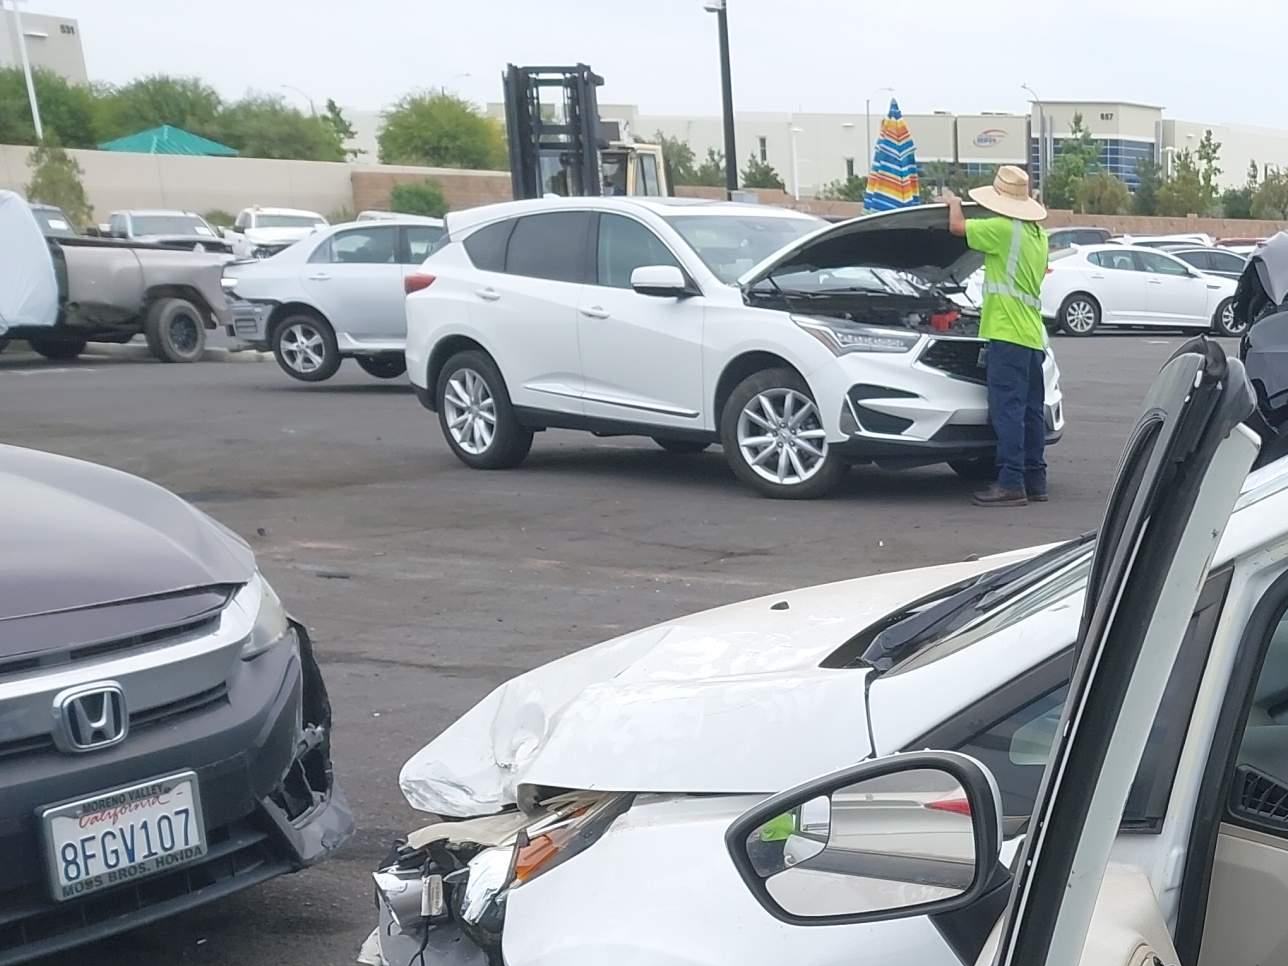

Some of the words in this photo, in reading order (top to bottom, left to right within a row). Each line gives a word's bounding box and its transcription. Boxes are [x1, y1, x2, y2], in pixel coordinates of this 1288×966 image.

[78, 796, 170, 829] California
[81, 793, 125, 814] MORENO
[127, 784, 164, 803] VALLEY
[61, 808, 190, 882] 8FGV107
[62, 877, 104, 898] MOSS
[107, 863, 151, 883] BROS.
[155, 846, 203, 869] HONDA
